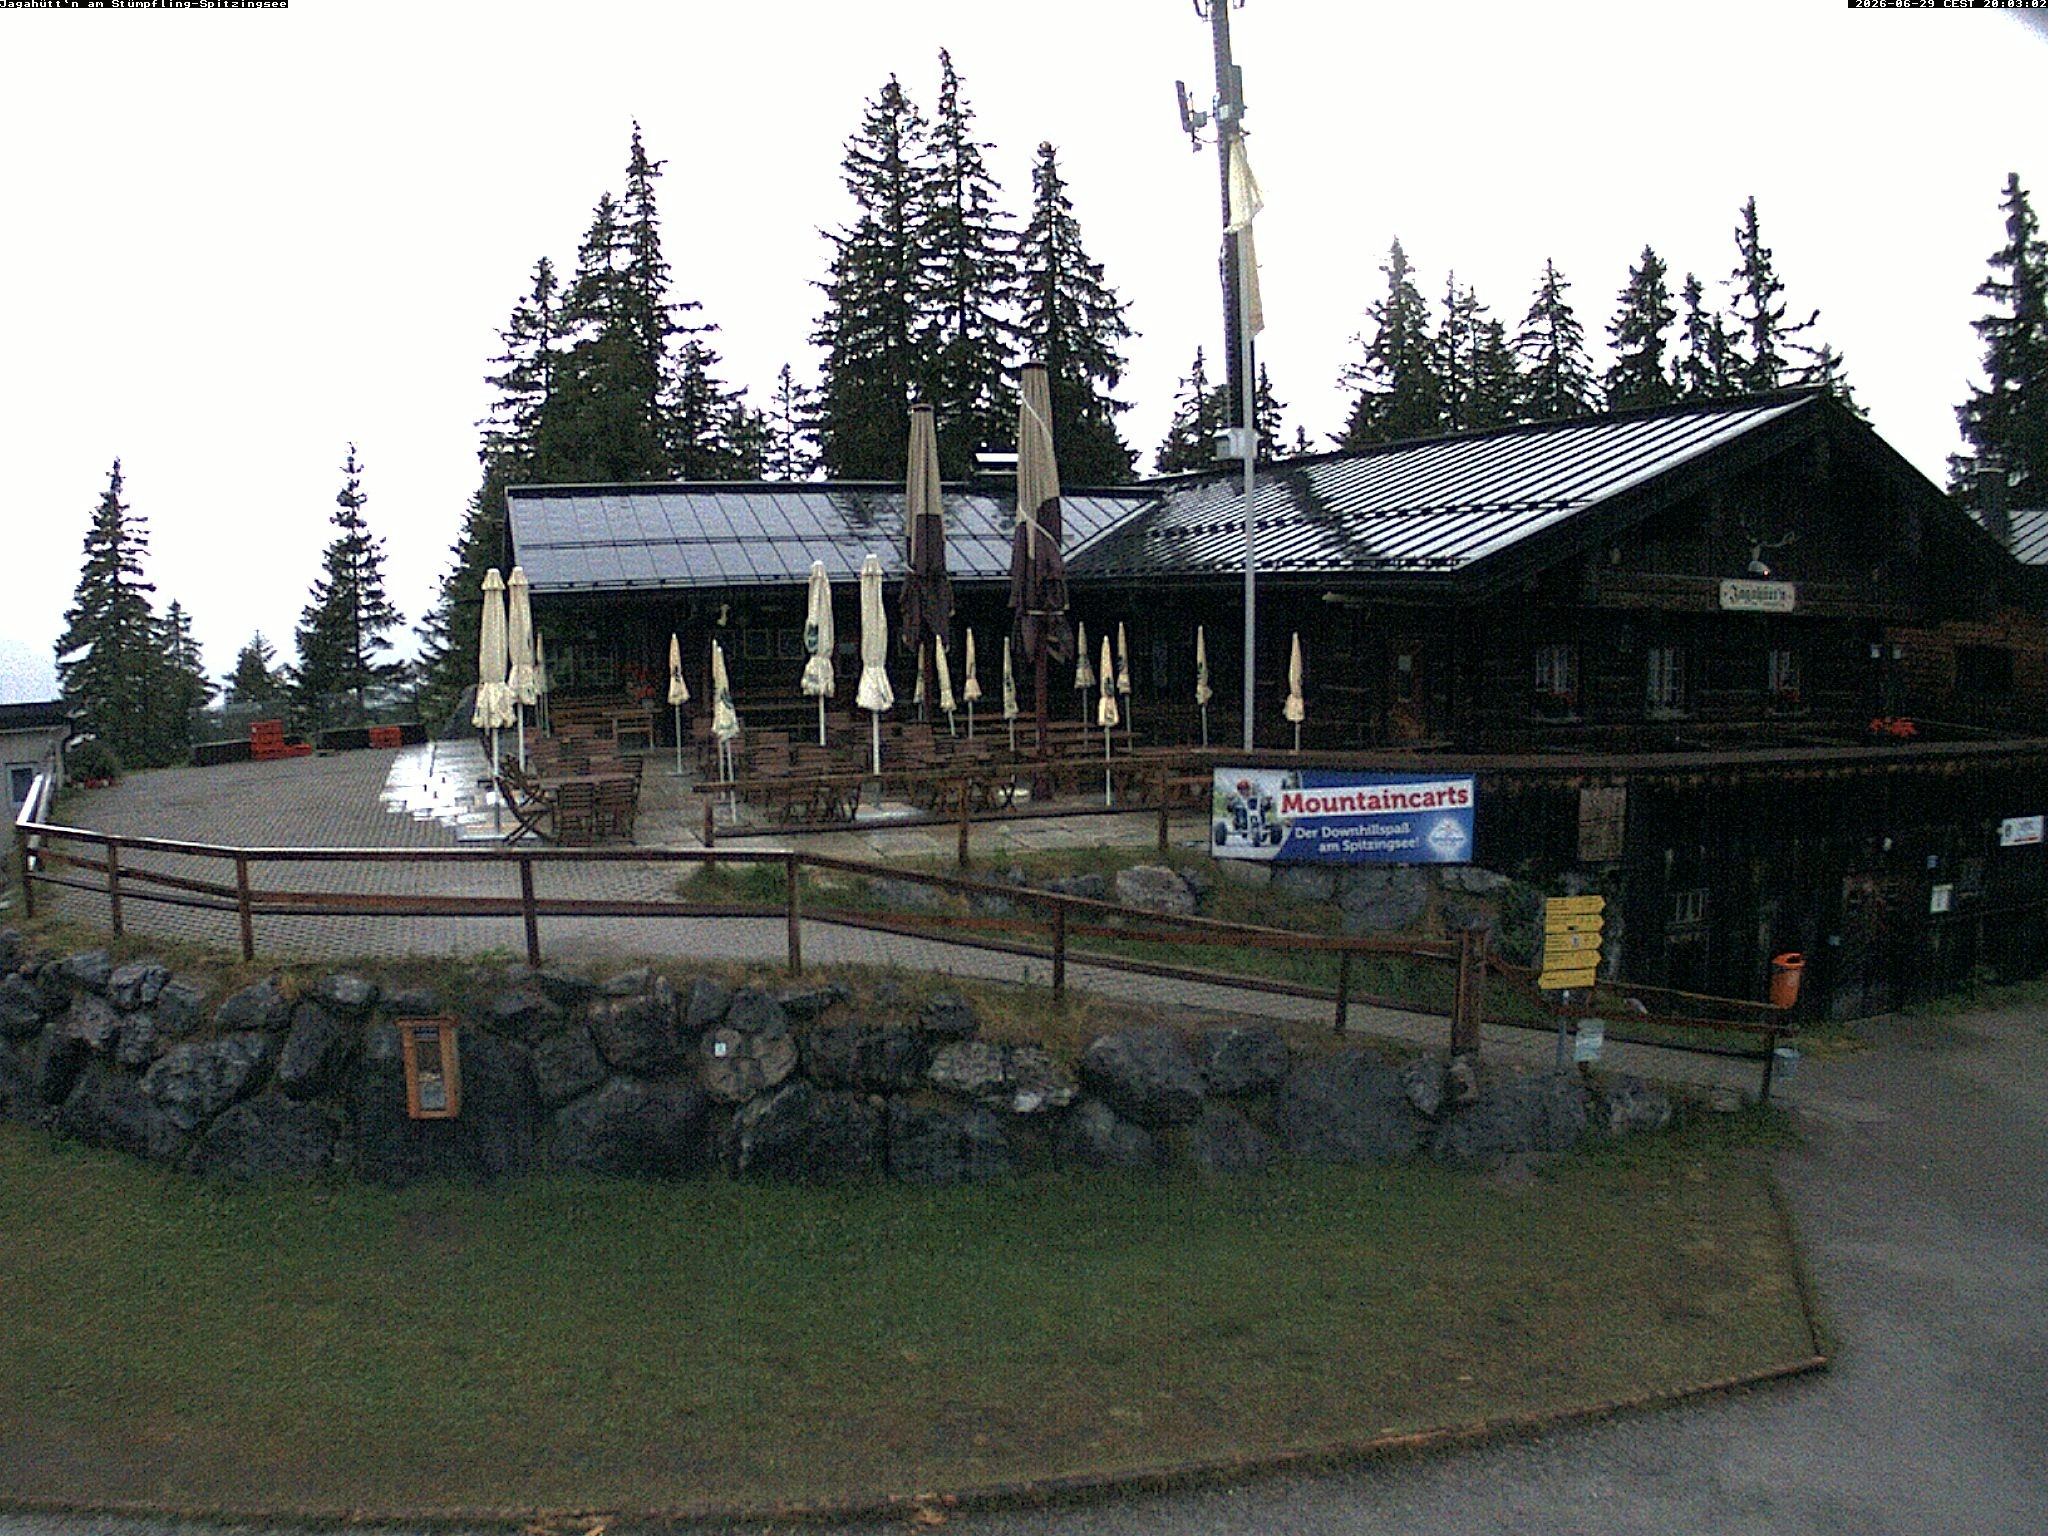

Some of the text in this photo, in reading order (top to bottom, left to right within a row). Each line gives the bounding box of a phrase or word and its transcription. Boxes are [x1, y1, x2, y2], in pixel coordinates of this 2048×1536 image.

[1280, 787, 1469, 814] Mountaincarts
[1295, 826, 1318, 839] Der
[1319, 842, 1339, 853] am
